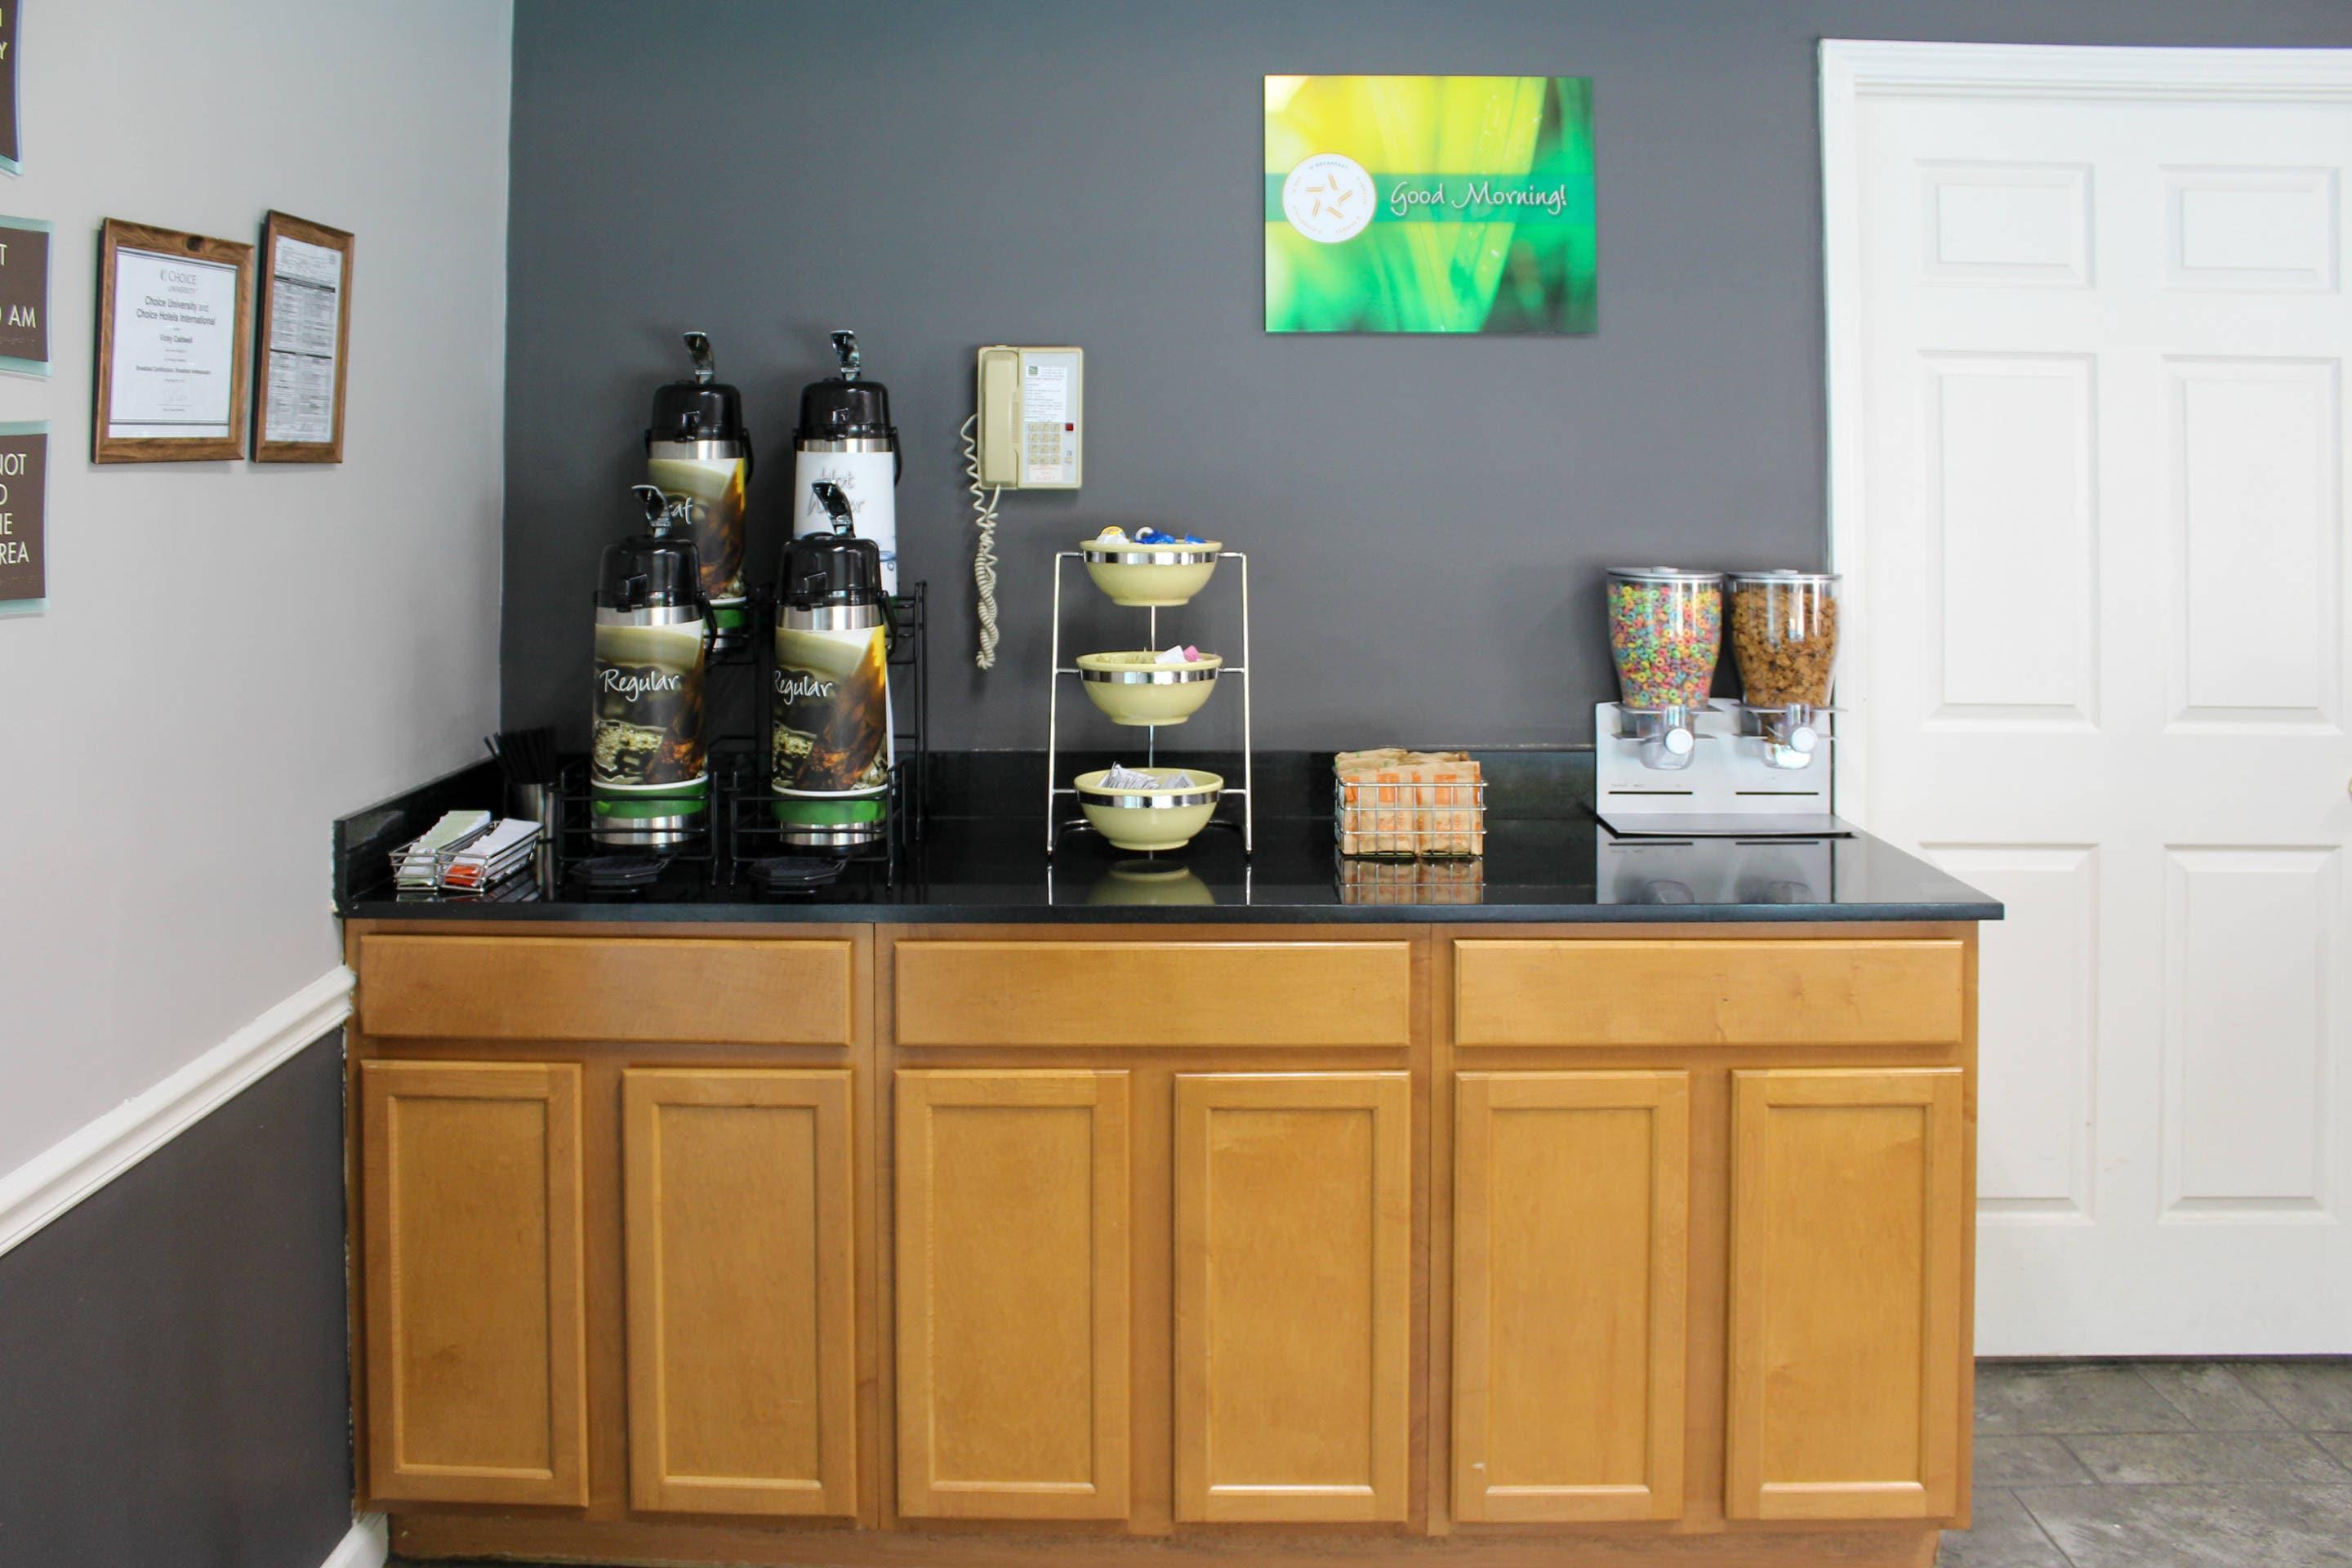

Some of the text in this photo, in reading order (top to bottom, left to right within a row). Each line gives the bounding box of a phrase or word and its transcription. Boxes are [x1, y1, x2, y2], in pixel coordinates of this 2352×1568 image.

[1391, 181, 1445, 216] Good
[1451, 181, 1567, 215] Morning!
[168, 270, 197, 285] CHOICE
[145, 296, 166, 307] Choice
[167, 299, 197, 313] University
[8, 305, 36, 328] AM
[136, 309, 216, 326] Choice Hotels International
[0, 452, 27, 476] OT
[599, 669, 680, 702] Regular
[774, 670, 834, 706] Regular
